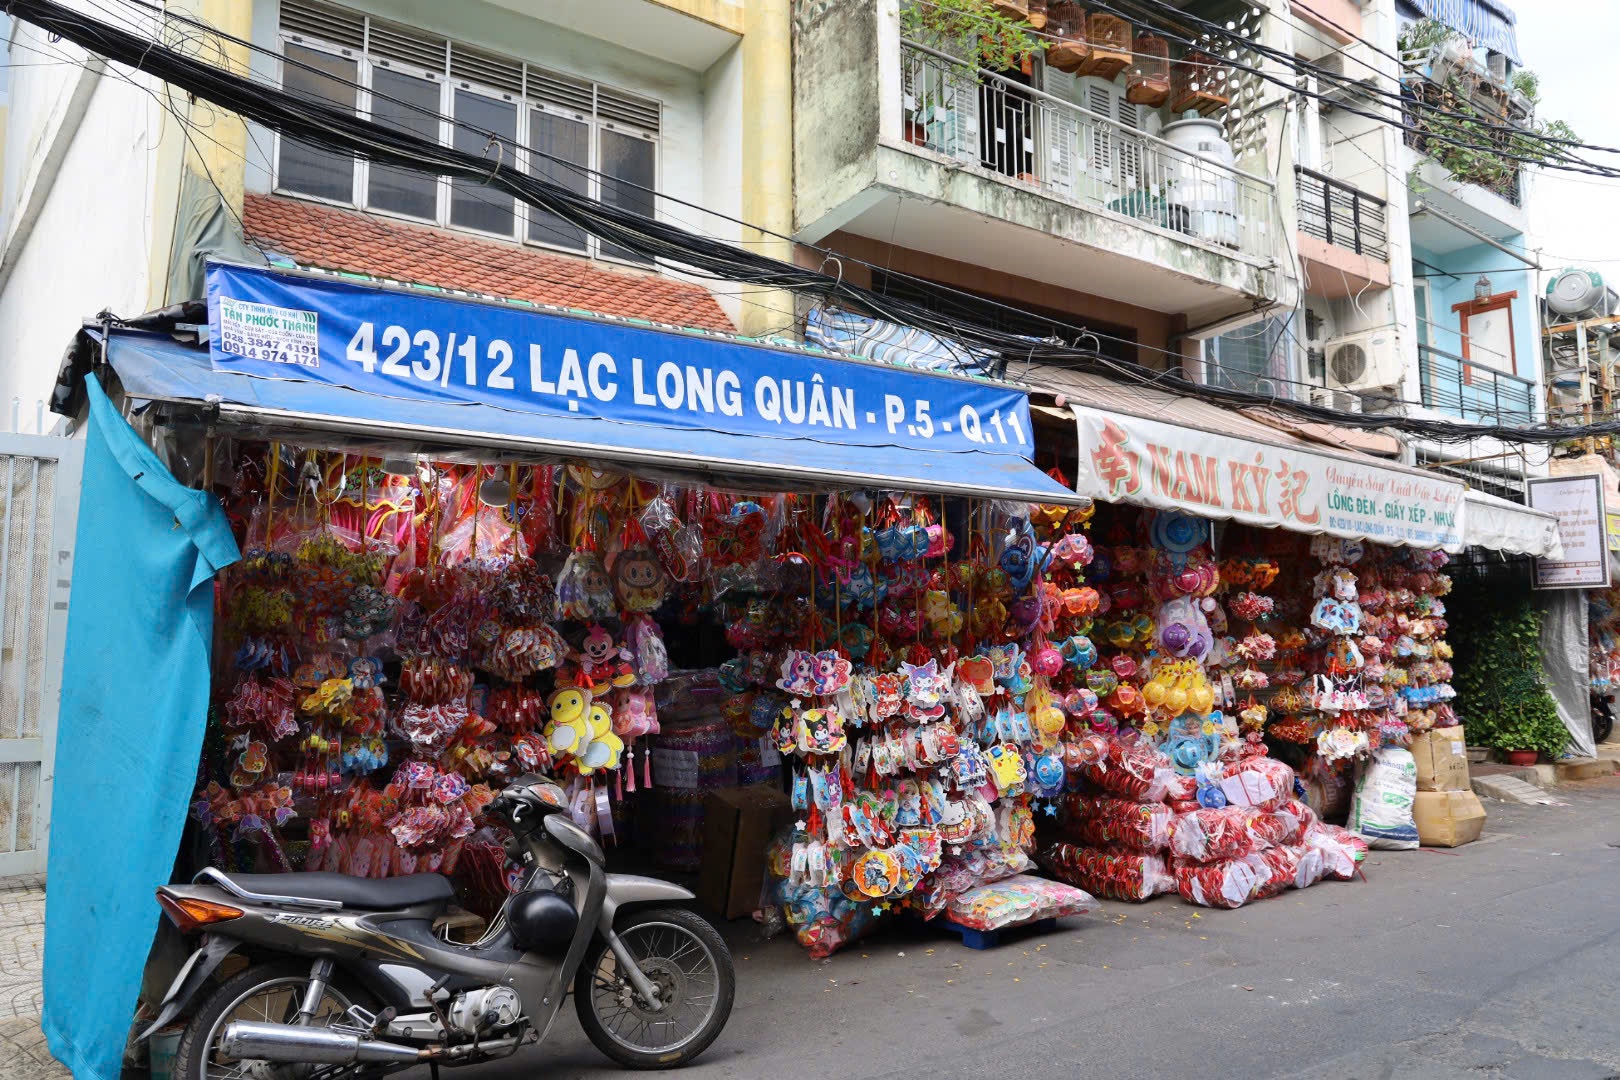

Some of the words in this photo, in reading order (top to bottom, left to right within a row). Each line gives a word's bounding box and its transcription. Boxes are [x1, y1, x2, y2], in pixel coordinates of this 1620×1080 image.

[246, 313, 279, 328] PHƯỚC
[223, 341, 257, 357] 0914
[261, 350, 288, 362] 974
[294, 354, 318, 367] 174
[224, 331, 280, 349] 028.3847
[285, 343, 317, 356] 4191
[346, 321, 514, 390] 423/12
[529, 343, 617, 412] LẠC
[632, 357, 743, 417] LONG
[754, 373, 857, 430] QUÂN
[885, 394, 934, 439] P.5
[959, 405, 1026, 445] Q.11
[1090, 416, 1141, 496] 南
[1146, 443, 1224, 509] NAM
[1275, 459, 1321, 525] 記
[1328, 488, 1353, 513] LỒNG
[1356, 495, 1376, 516] ĐÈN
[1384, 500, 1405, 522] GIẤY
[1408, 502, 1426, 524] XẾP
